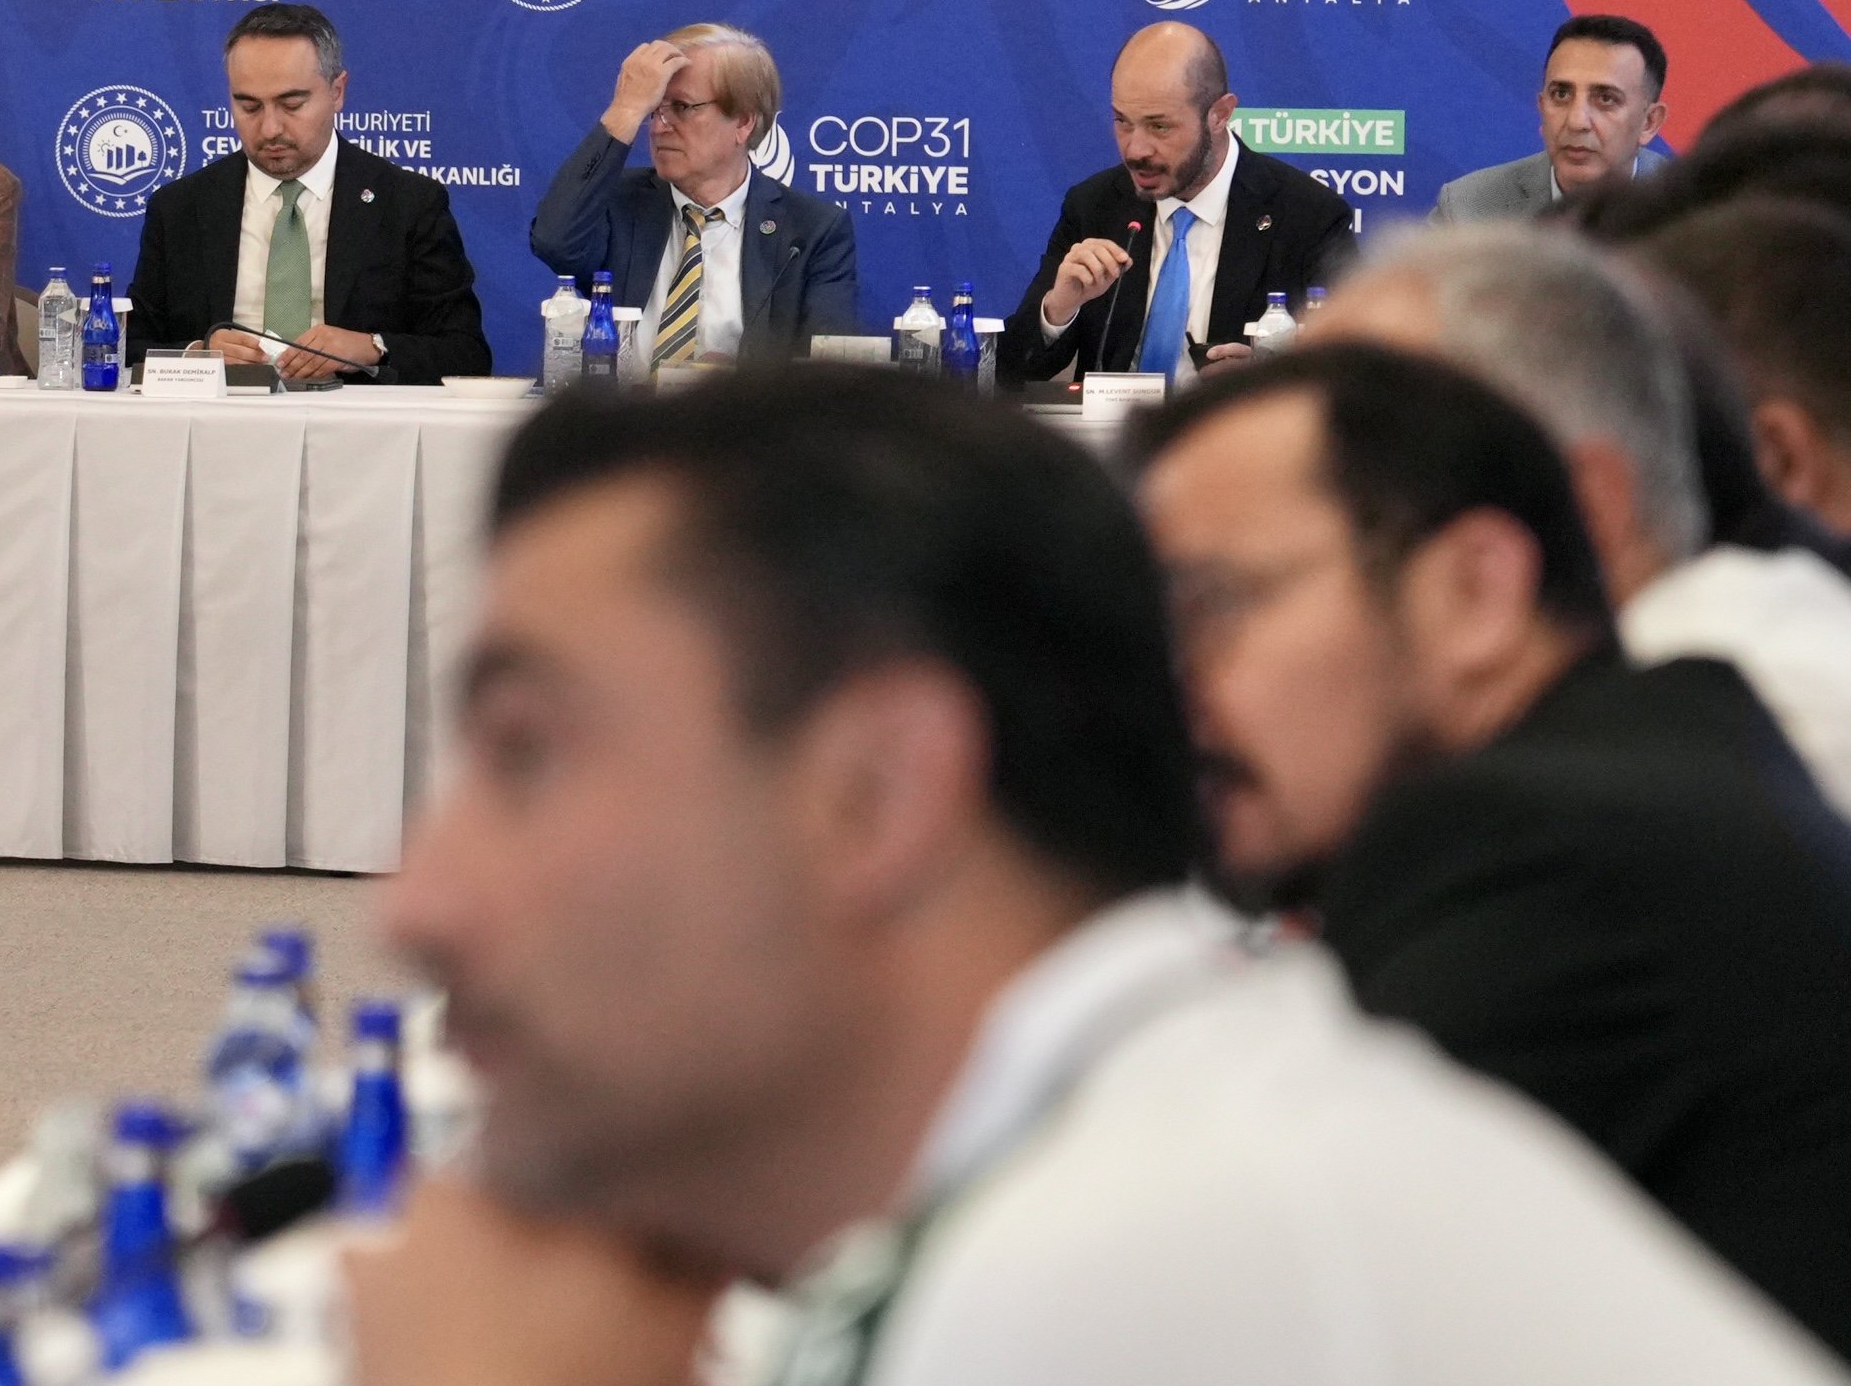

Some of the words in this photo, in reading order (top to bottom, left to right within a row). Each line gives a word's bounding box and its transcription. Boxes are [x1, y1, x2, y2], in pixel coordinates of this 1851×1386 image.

[334, 110, 430, 132] HURİYETİ
[1249, 112, 1394, 145] TÜRKİYE
[404, 140, 431, 158] VE
[810, 116, 969, 157] COP31
[809, 164, 968, 194] TÜRKİYE
